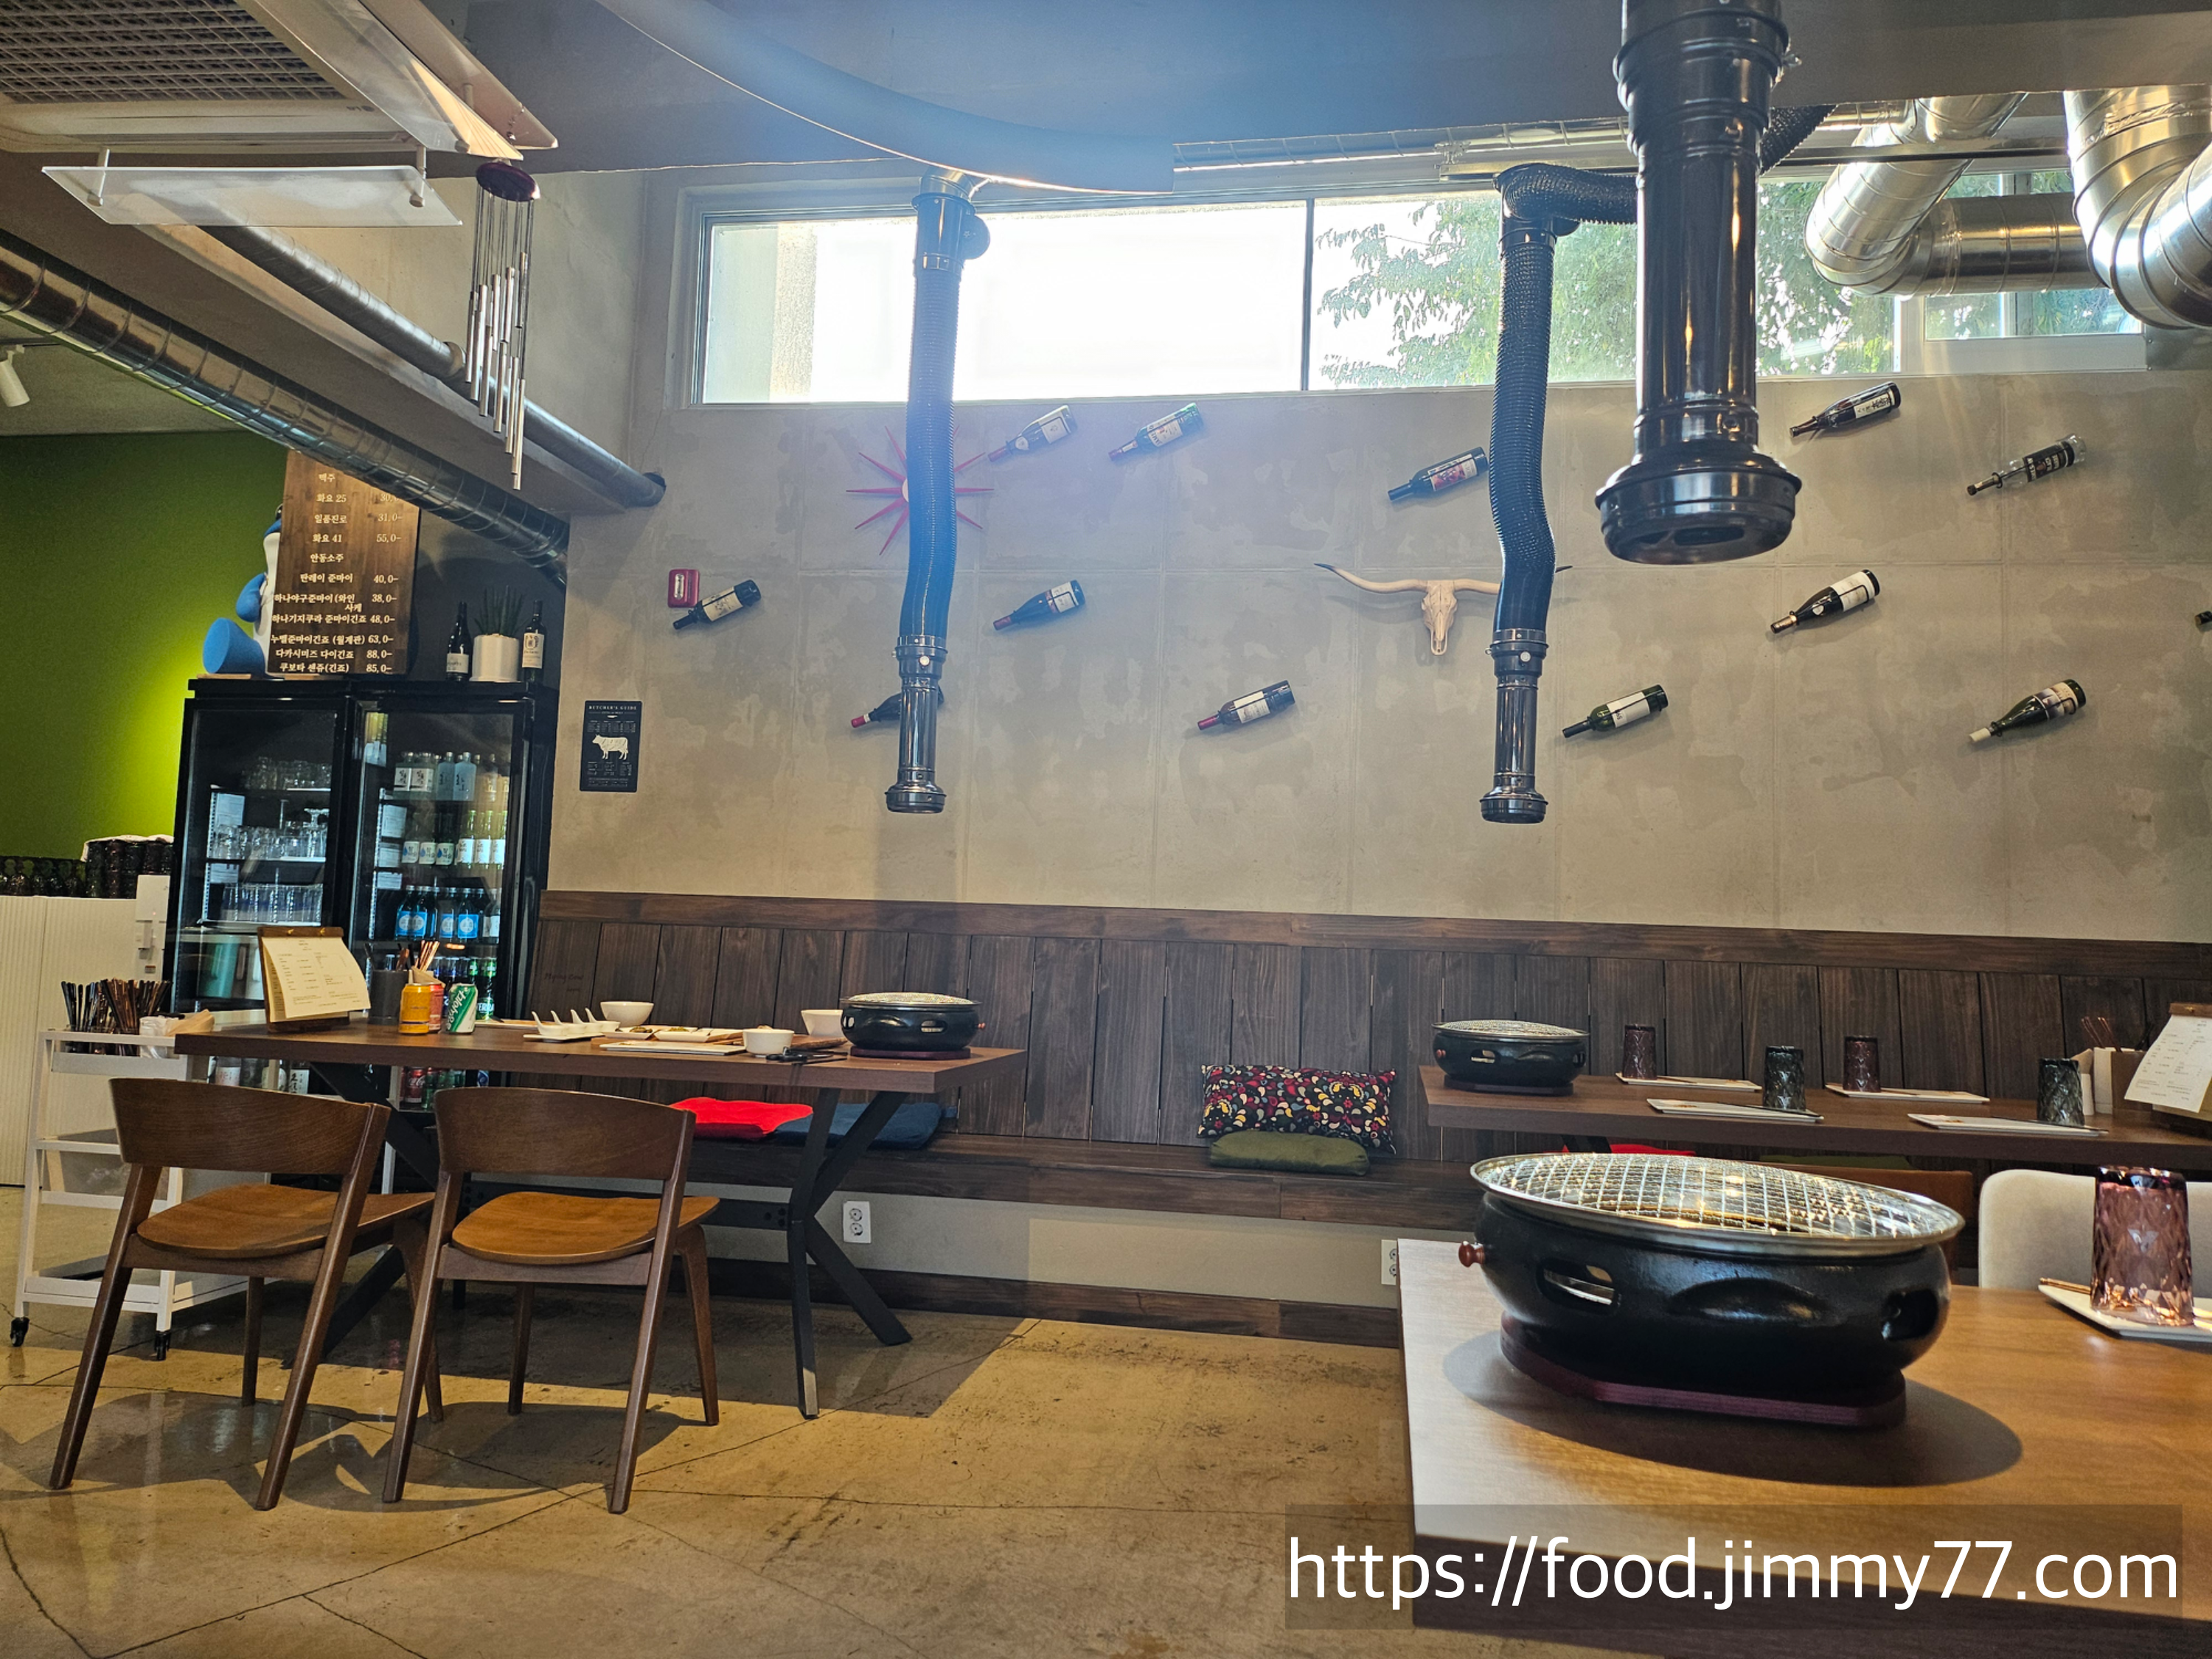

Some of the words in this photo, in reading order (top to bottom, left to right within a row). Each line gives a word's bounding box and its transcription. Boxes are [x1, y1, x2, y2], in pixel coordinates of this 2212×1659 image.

[319, 473, 335, 482] 맥주
[316, 493, 333, 502] 화요
[336, 494, 347, 502] 25
[313, 533, 330, 543] 화요
[332, 534, 342, 543] 41
[310, 553, 344, 563] 안동소주
[328, 573, 353, 583] 준마이
